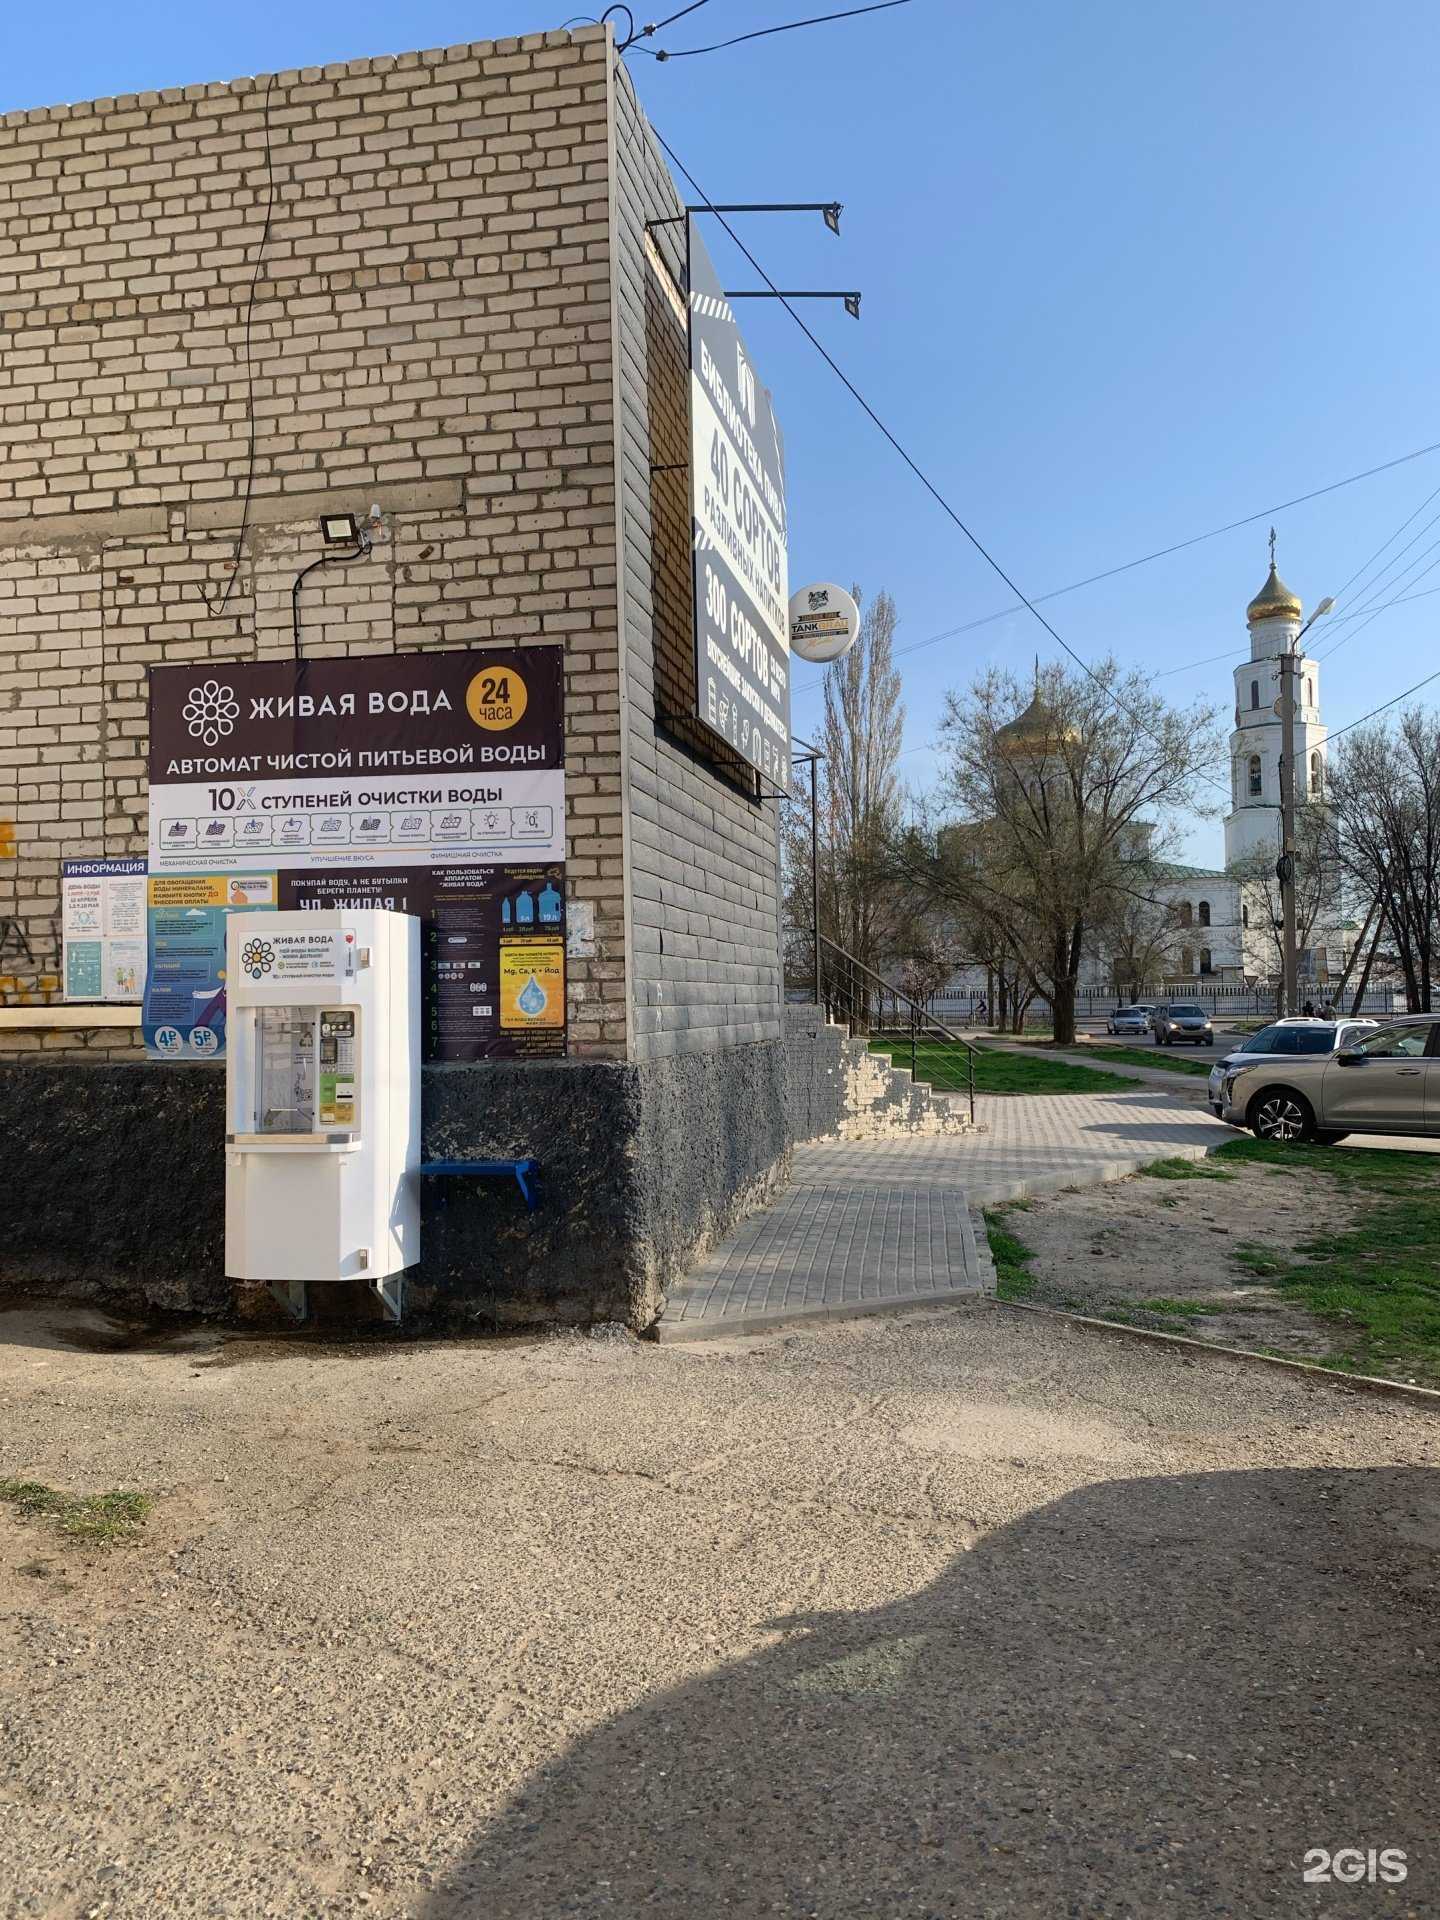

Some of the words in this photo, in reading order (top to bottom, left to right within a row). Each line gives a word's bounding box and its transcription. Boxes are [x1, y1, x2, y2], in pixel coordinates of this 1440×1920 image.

[701, 338, 764, 490] БИБЛИОТЕКА
[764, 469, 784, 530] ПИВА
[710, 428, 728, 507] 40
[733, 466, 781, 595] СОРТОВ
[704, 484, 754, 583] РАЗЛИВНЫХ
[755, 578, 785, 637] НАПИТКОВ
[705, 563, 727, 635] 300
[730, 600, 769, 688] СОРТОВ
[481, 677, 511, 705] 24
[249, 693, 356, 719] ЖИВАЯ
[368, 689, 453, 716] ВОДА
[479, 704, 513, 721] часа
[166, 756, 262, 775] АВТОМАТ
[267, 749, 351, 770] ЧИСТОЙ
[358, 743, 474, 767] ПИТЬЕВОЙ
[480, 744, 546, 764] ВОДЫ
[261, 790, 352, 810] СТУПЕНЕЙ
[358, 790, 442, 806] ОЧИСТКИ
[448, 787, 503, 803] ВОДЫ
[310, 855, 352, 863] УЛУЧШЕНИЕ
[353, 854, 375, 862] ВКУСА
[430, 852, 471, 860] ФИНИШНАЯ
[471, 851, 503, 859] ОЧИСТКА
[67, 862, 145, 875] ИНФОРМАЦИЯ
[159, 859, 208, 867] МЕХАНИЧЕСКАЯ
[444, 874, 482, 882] АППАРАТОМ
[446, 868, 495, 876] ПОЛЬЗОВАТЬСЯ
[290, 878, 327, 887] ПОКУПАЙ
[328, 878, 351, 887] ВОДУ,
[371, 877, 408, 885] БУТЫЛКИ
[317, 887, 345, 895] БЕРЕГИ
[346, 886, 382, 895] ПЛАНЕТУ!
[333, 896, 396, 911] ЖИЛАЯ
[272, 936, 307, 945] ЖИВАЯ
[308, 935, 334, 944] ВОДА
[503, 967, 518, 976] Mg,
[544, 966, 560, 975] Йод
